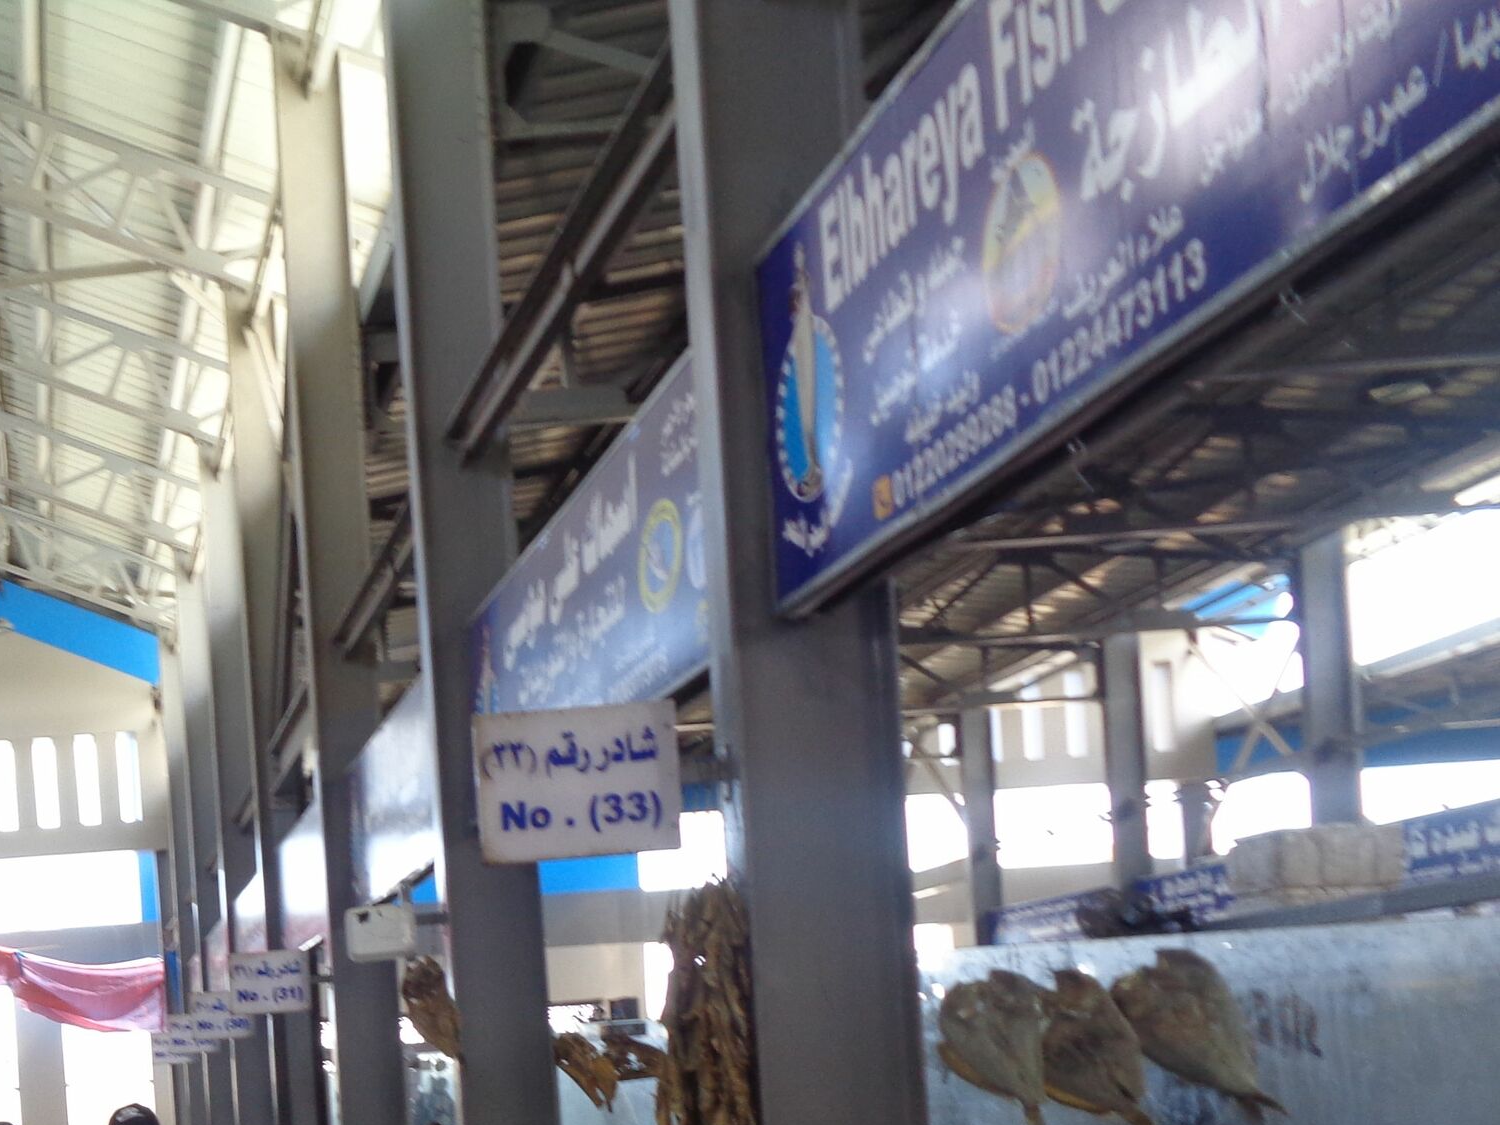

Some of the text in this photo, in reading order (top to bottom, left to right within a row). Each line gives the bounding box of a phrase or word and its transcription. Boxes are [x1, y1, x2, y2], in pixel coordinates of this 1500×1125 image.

[546, 731, 591, 779] رقم
[597, 726, 658, 773] شادر
[590, 790, 662, 833] (33)
